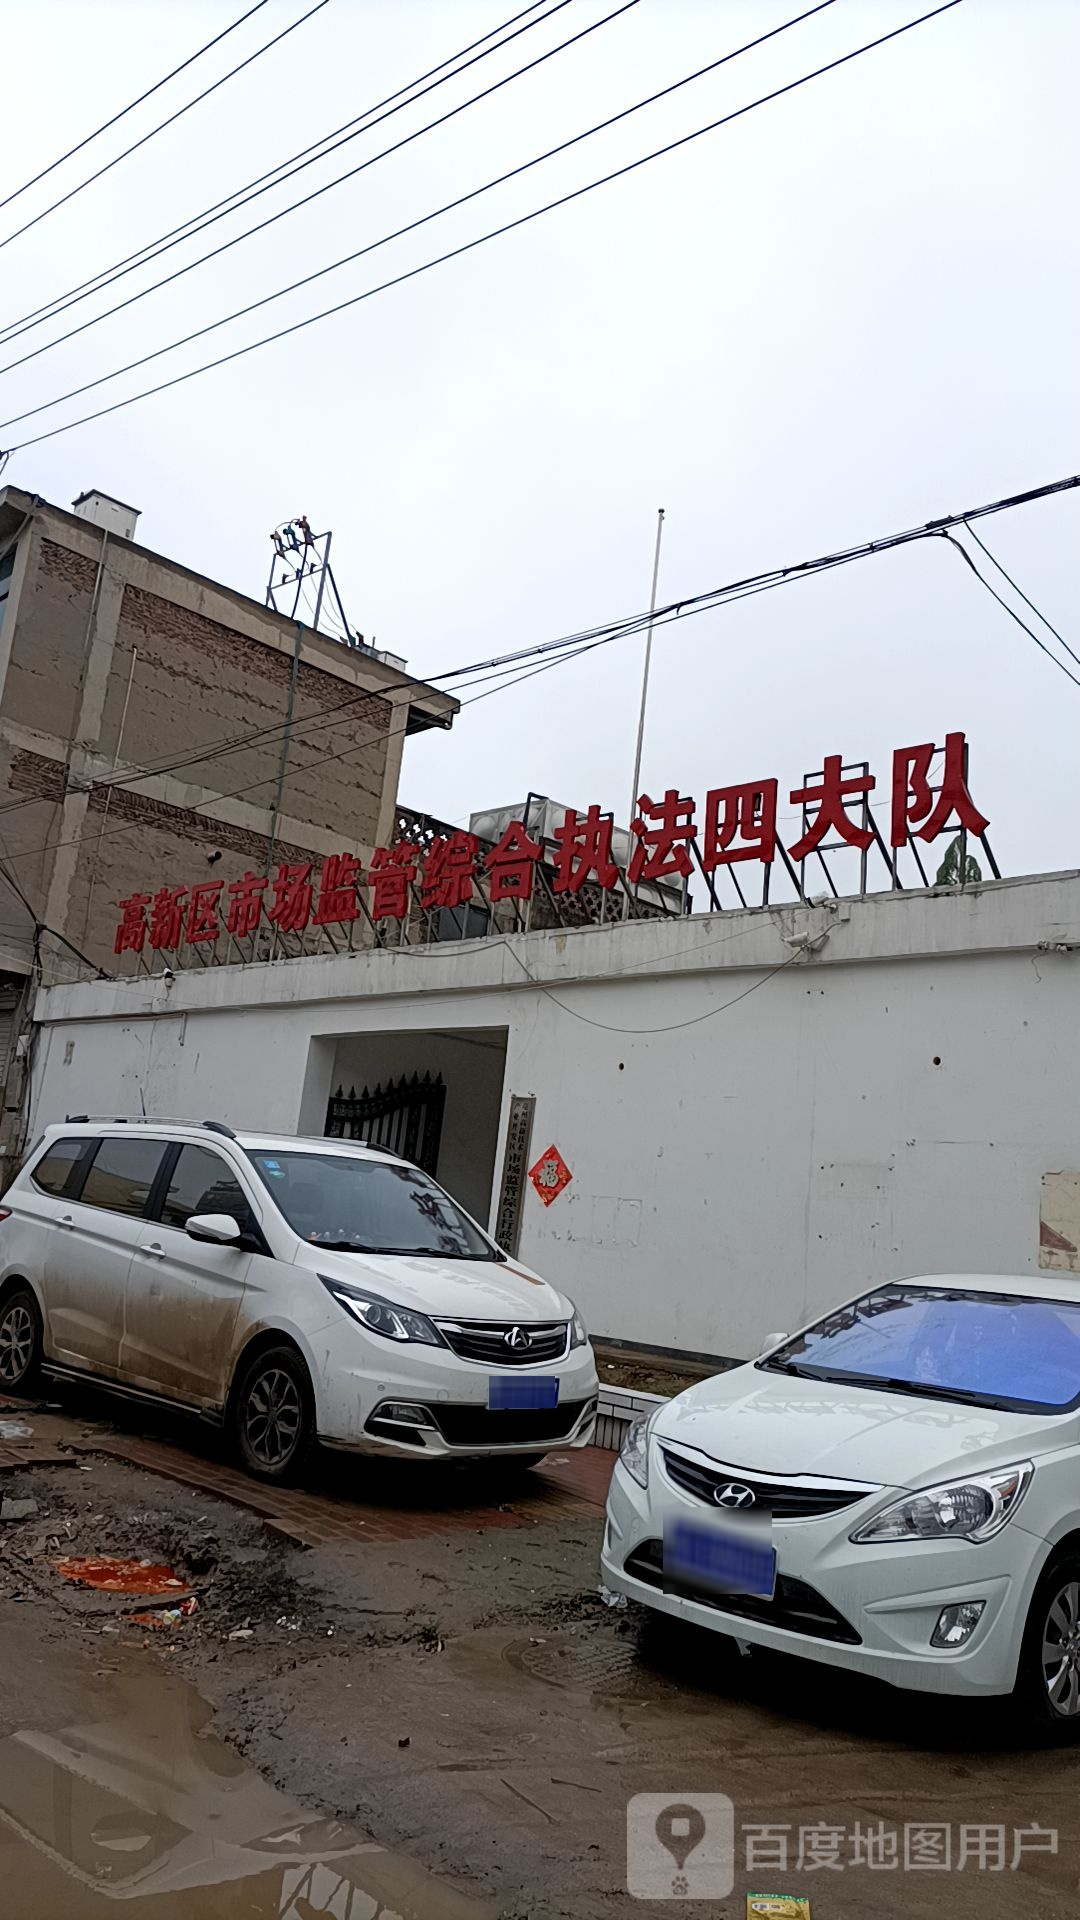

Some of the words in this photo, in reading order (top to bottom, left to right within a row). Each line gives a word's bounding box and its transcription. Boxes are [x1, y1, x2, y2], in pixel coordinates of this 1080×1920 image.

[114, 733, 988, 955] 高新区市场监管综合执法四大队
